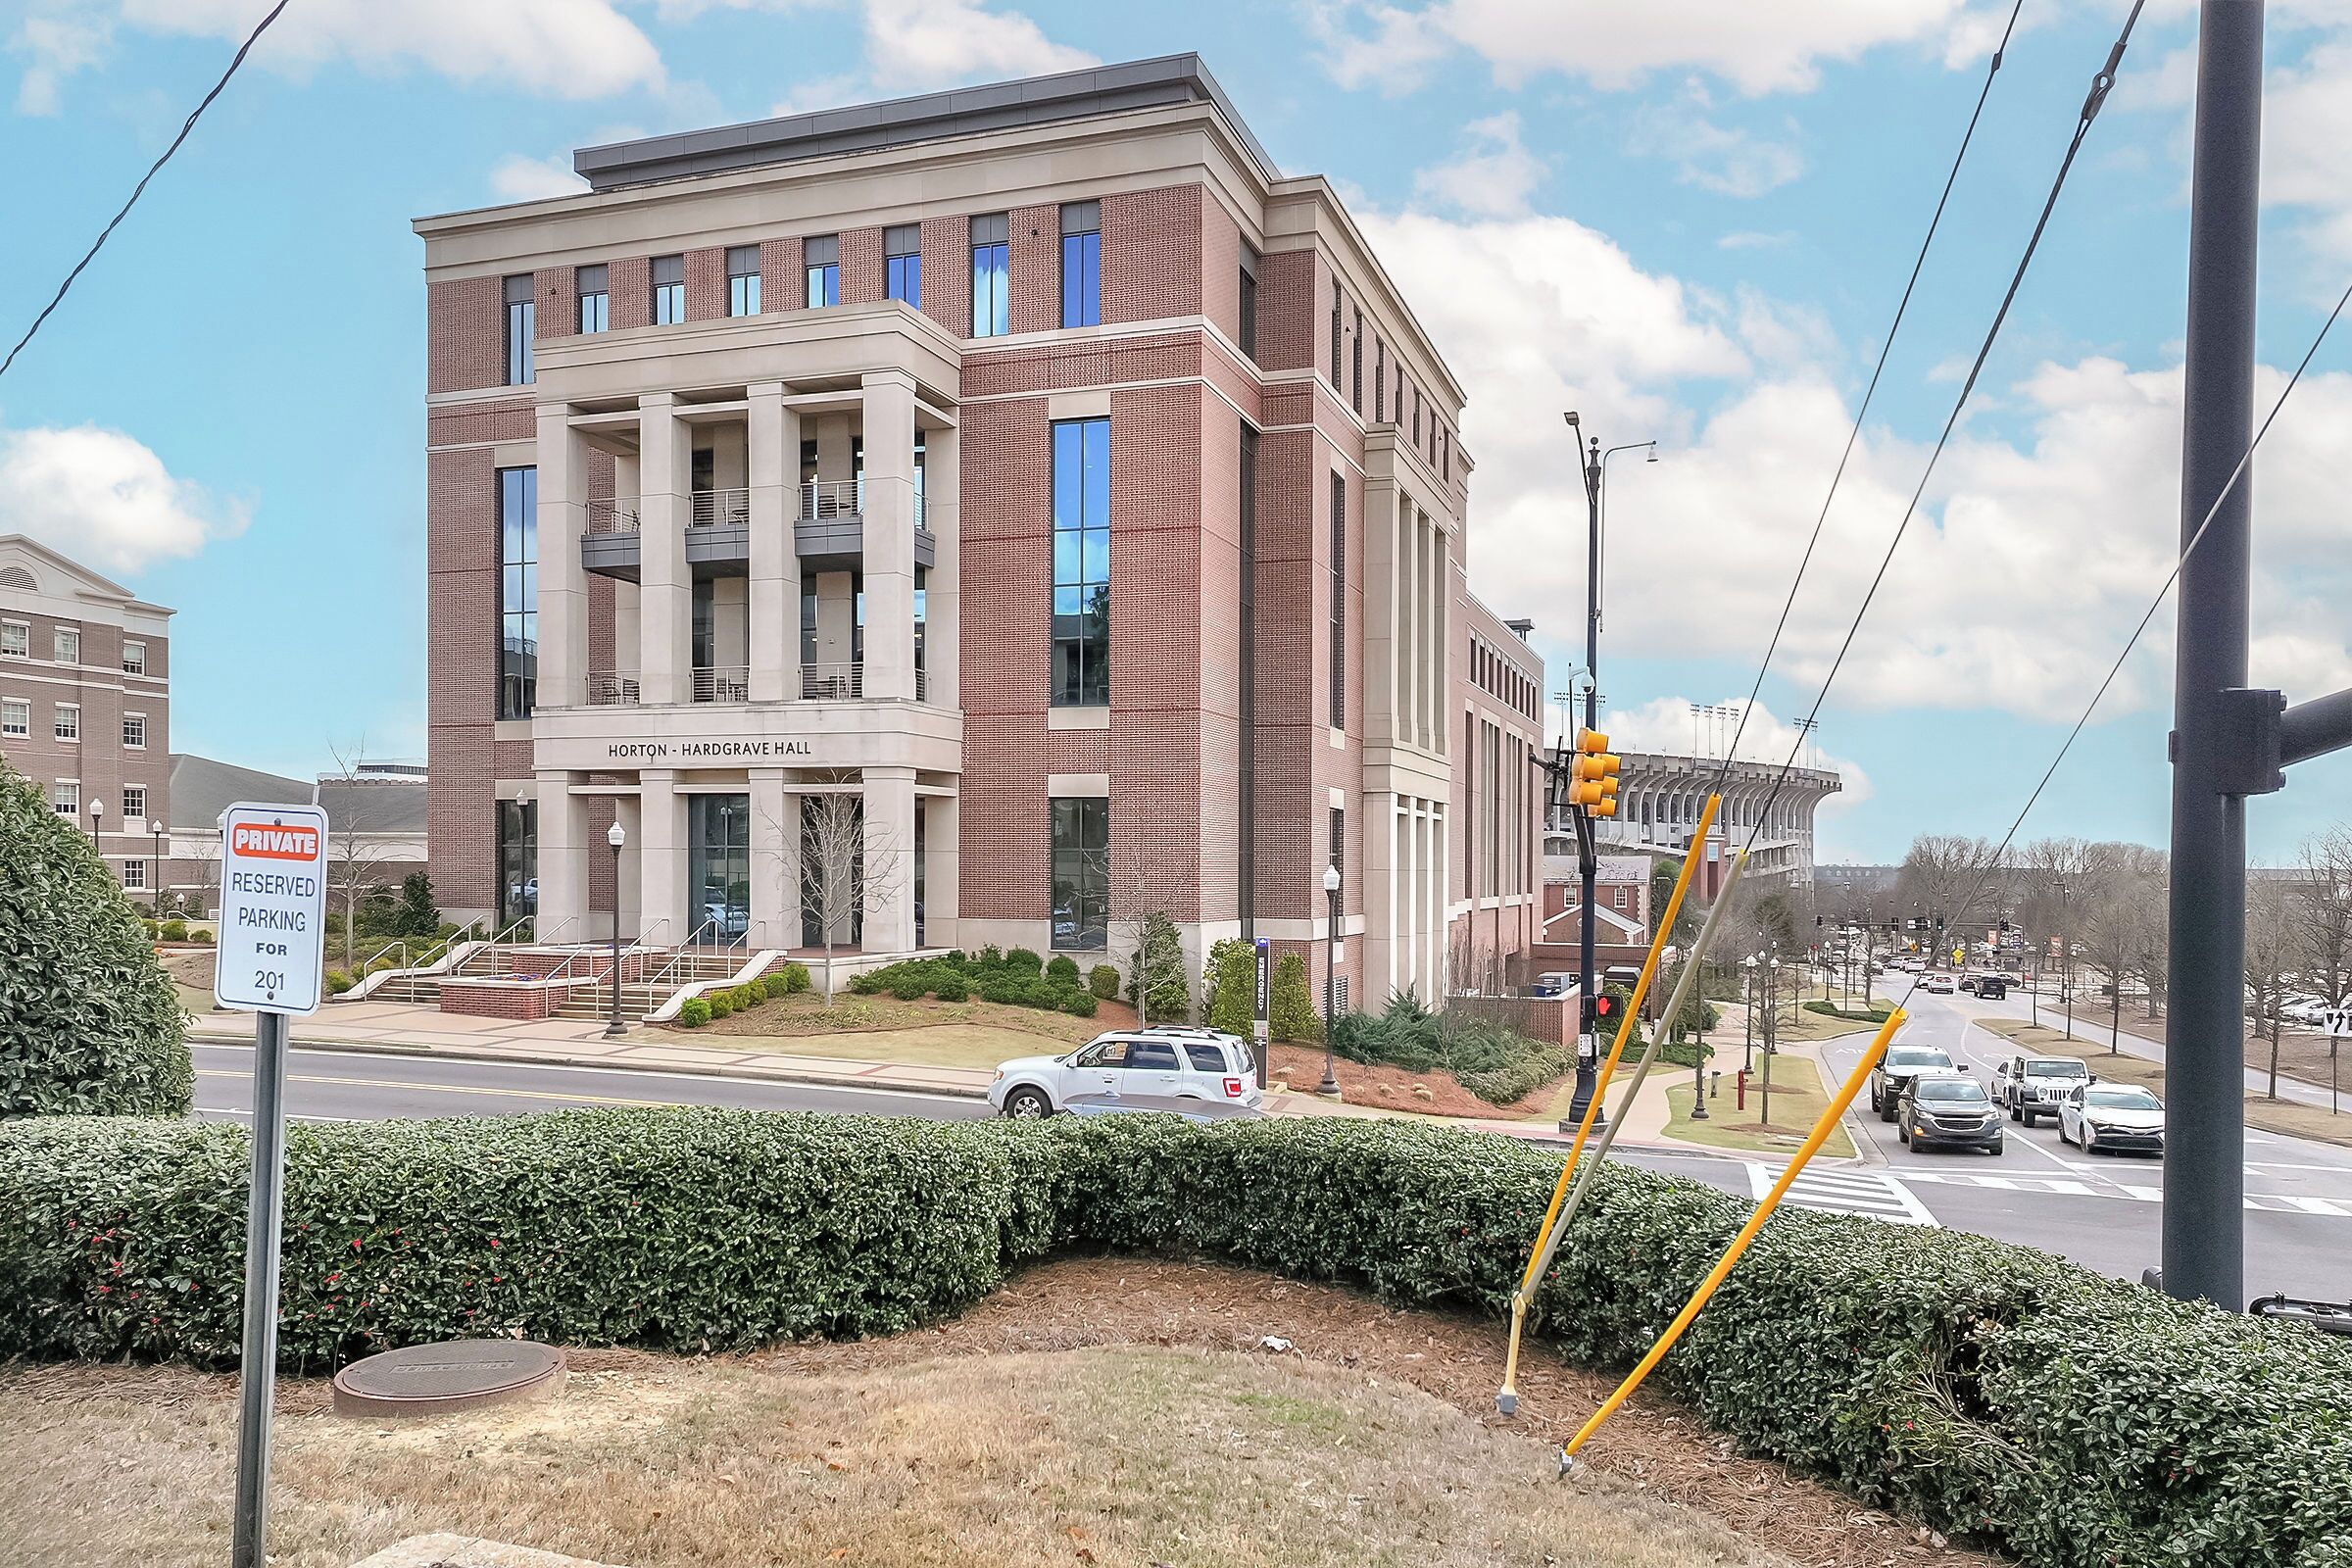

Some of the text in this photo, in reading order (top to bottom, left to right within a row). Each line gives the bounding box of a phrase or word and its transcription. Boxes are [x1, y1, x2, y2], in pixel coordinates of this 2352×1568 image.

[609, 744, 667, 758] HORTON
[681, 742, 769, 757] HARDGRAVE
[774, 741, 811, 755] HALL
[235, 829, 316, 855] PRIVATE
[232, 872, 315, 898] RESERVED
[238, 906, 306, 932] PARKING
[256, 942, 287, 956] FOR
[254, 970, 284, 991] 201
